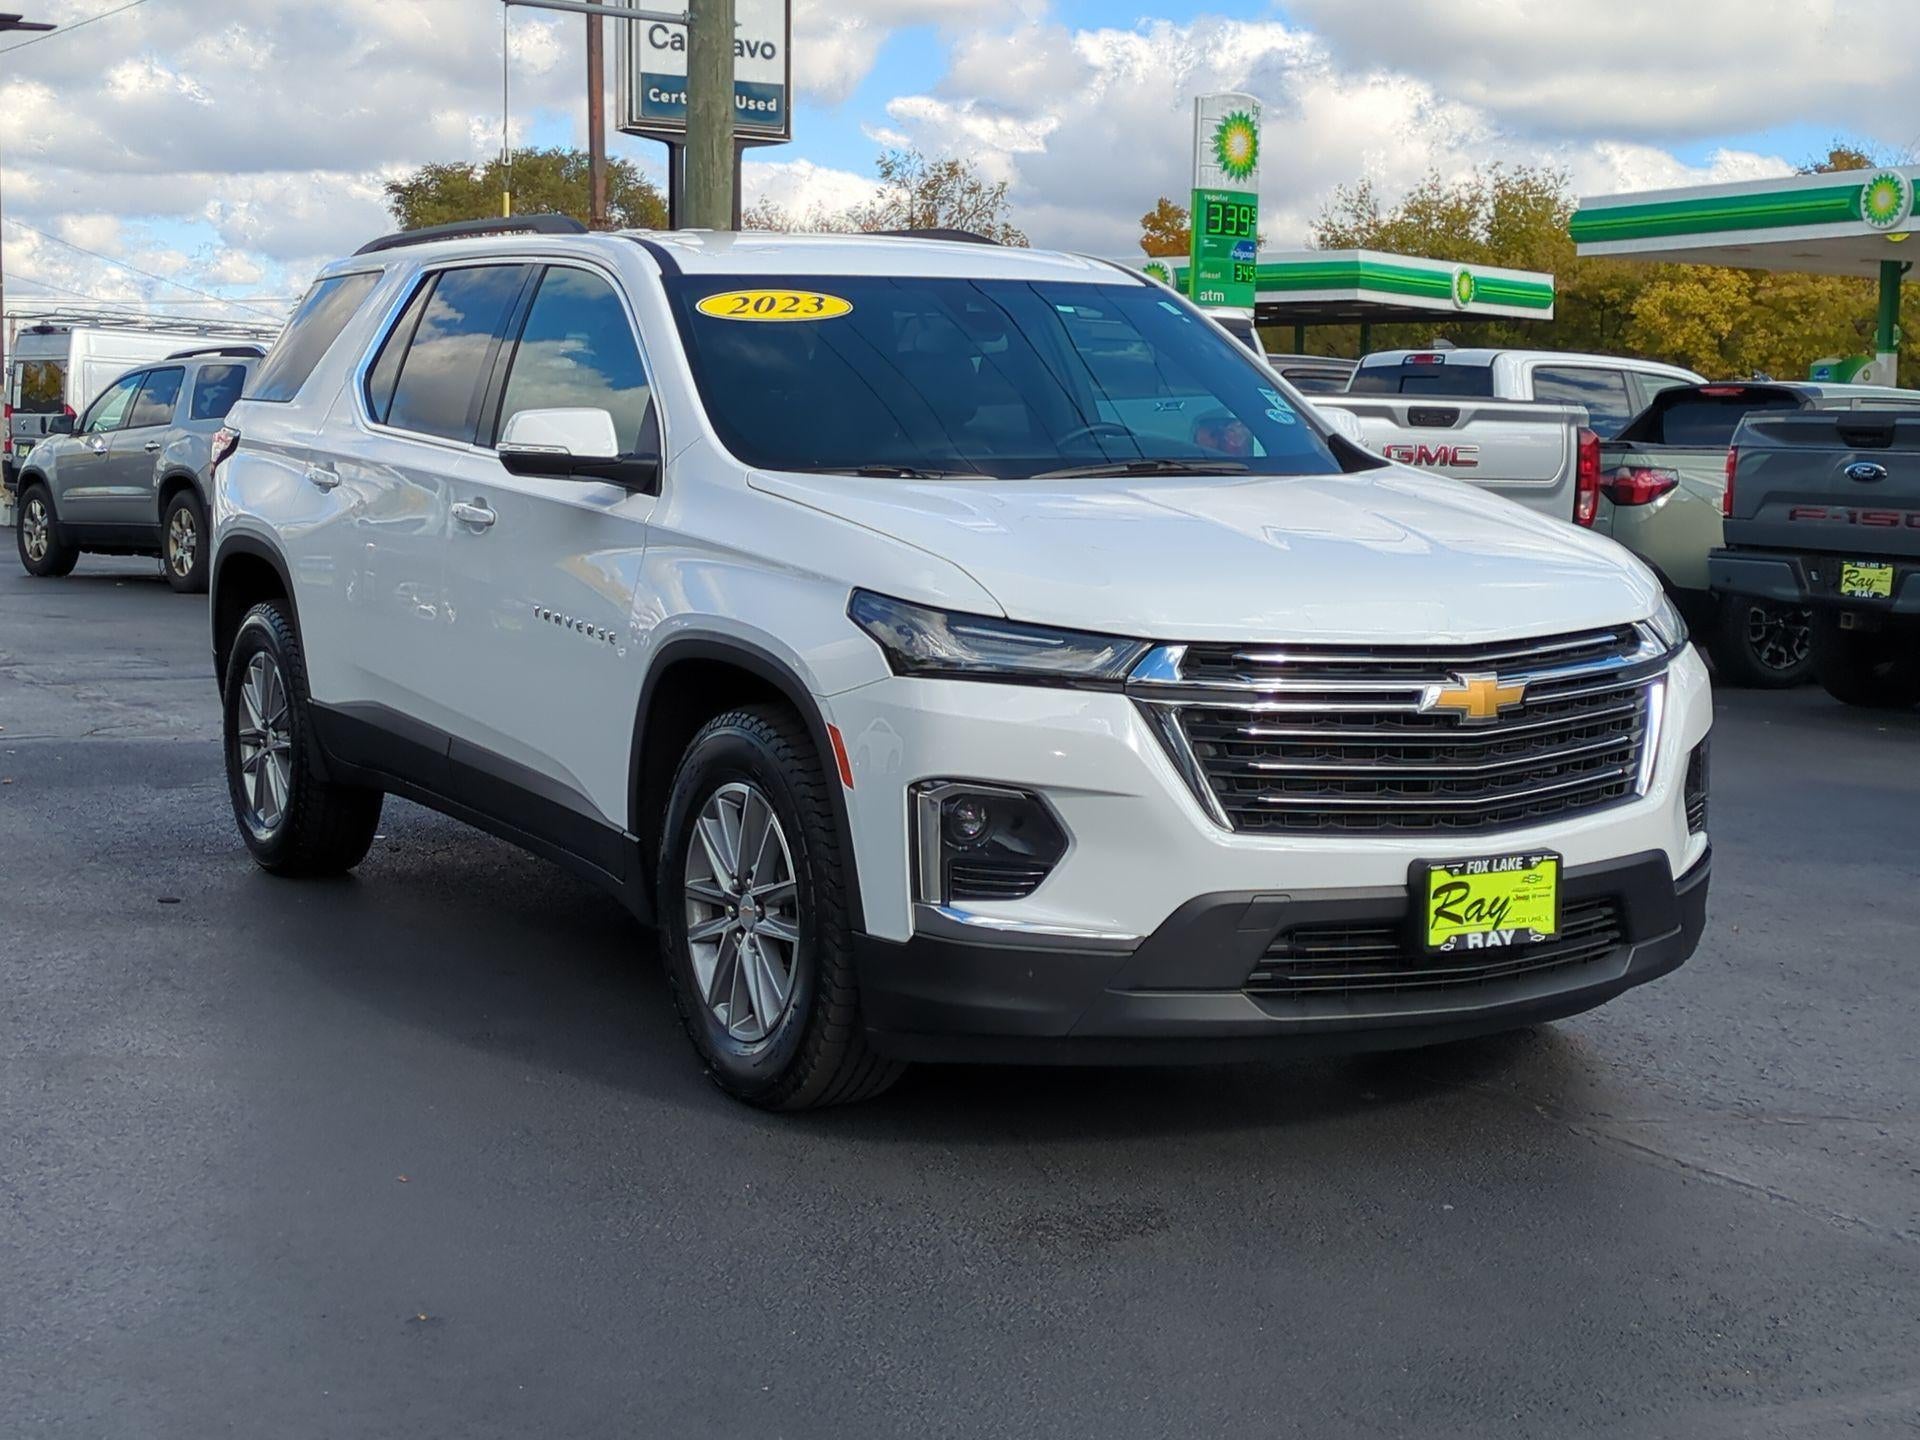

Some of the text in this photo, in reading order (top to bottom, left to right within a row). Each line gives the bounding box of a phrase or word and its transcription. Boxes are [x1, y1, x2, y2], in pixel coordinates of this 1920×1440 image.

[735, 95, 777, 112] Used
[727, 296, 826, 315] 2023
[1200, 290, 1225, 302] atm
[1383, 443, 1478, 467] GMC
[1843, 569, 1875, 592] Ray
[532, 605, 616, 646] TRAVERSE
[1466, 861, 1490, 875] FOX
[1492, 857, 1524, 872] LAKE
[1431, 881, 1512, 931] Ray
[1467, 929, 1516, 949] RAY
